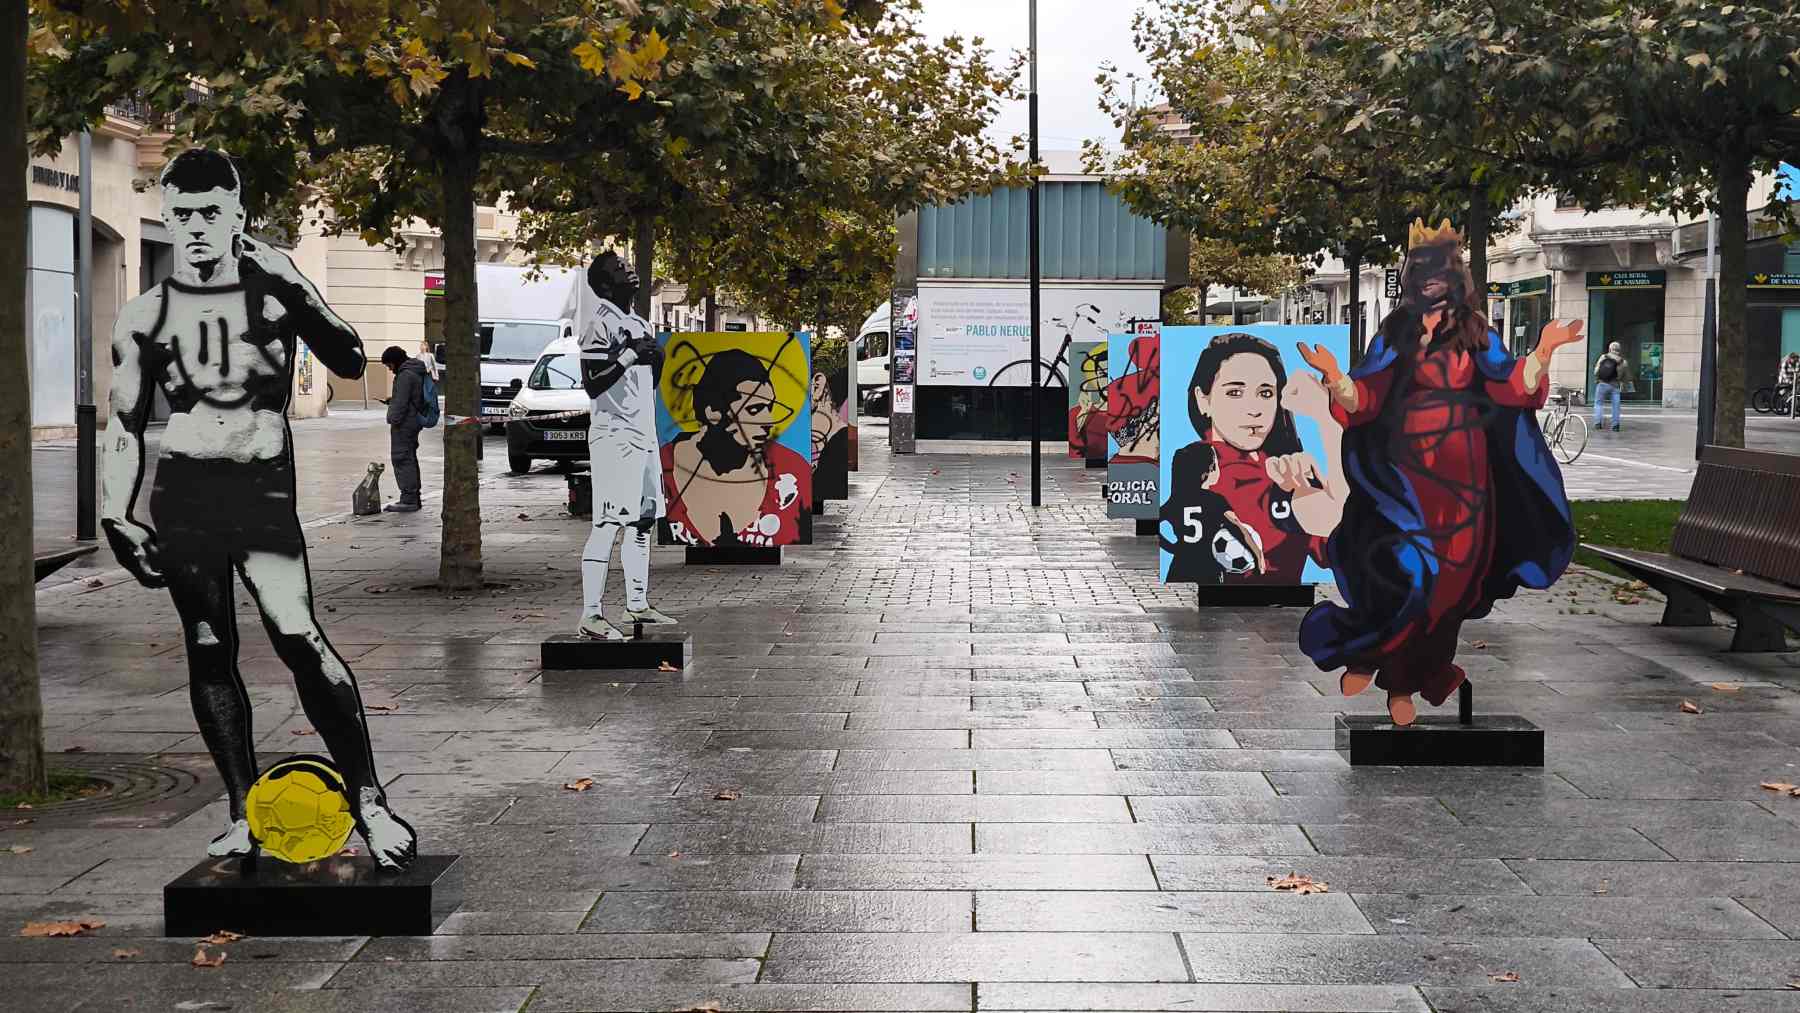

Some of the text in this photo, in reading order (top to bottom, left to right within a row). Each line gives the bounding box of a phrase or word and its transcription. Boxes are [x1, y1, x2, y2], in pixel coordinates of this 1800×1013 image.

[1387, 271, 1397, 297] TOUS
[966, 324, 998, 337] PABLO
[999, 324, 1032, 337] NERUD
[1107, 480, 1156, 492] OLICIA
[1183, 506, 1203, 544] 5
